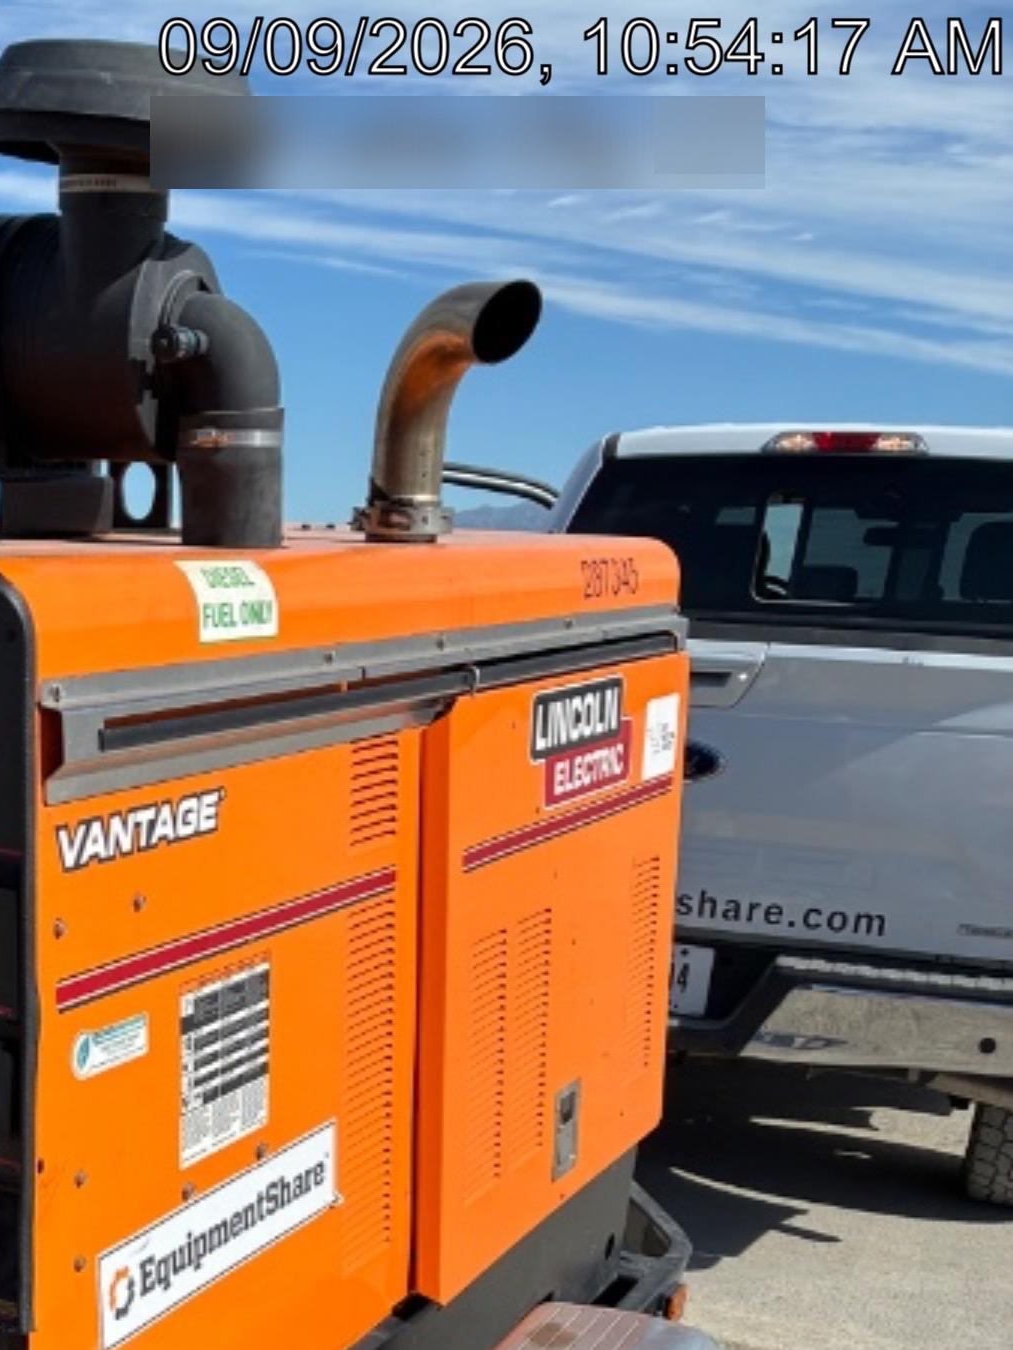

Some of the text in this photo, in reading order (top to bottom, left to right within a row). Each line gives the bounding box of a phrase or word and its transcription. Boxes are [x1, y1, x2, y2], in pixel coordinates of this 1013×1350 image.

[201, 566, 254, 590] DIESEL
[580, 559, 640, 598] 287345
[203, 600, 274, 630] FUEL ONLY
[535, 687, 622, 750] LINCOLN
[554, 742, 625, 796] ELECTRIC
[57, 792, 223, 870] VANTAGE
[675, 890, 886, 936] share.com
[139, 1160, 326, 1297] EquipmentShare
